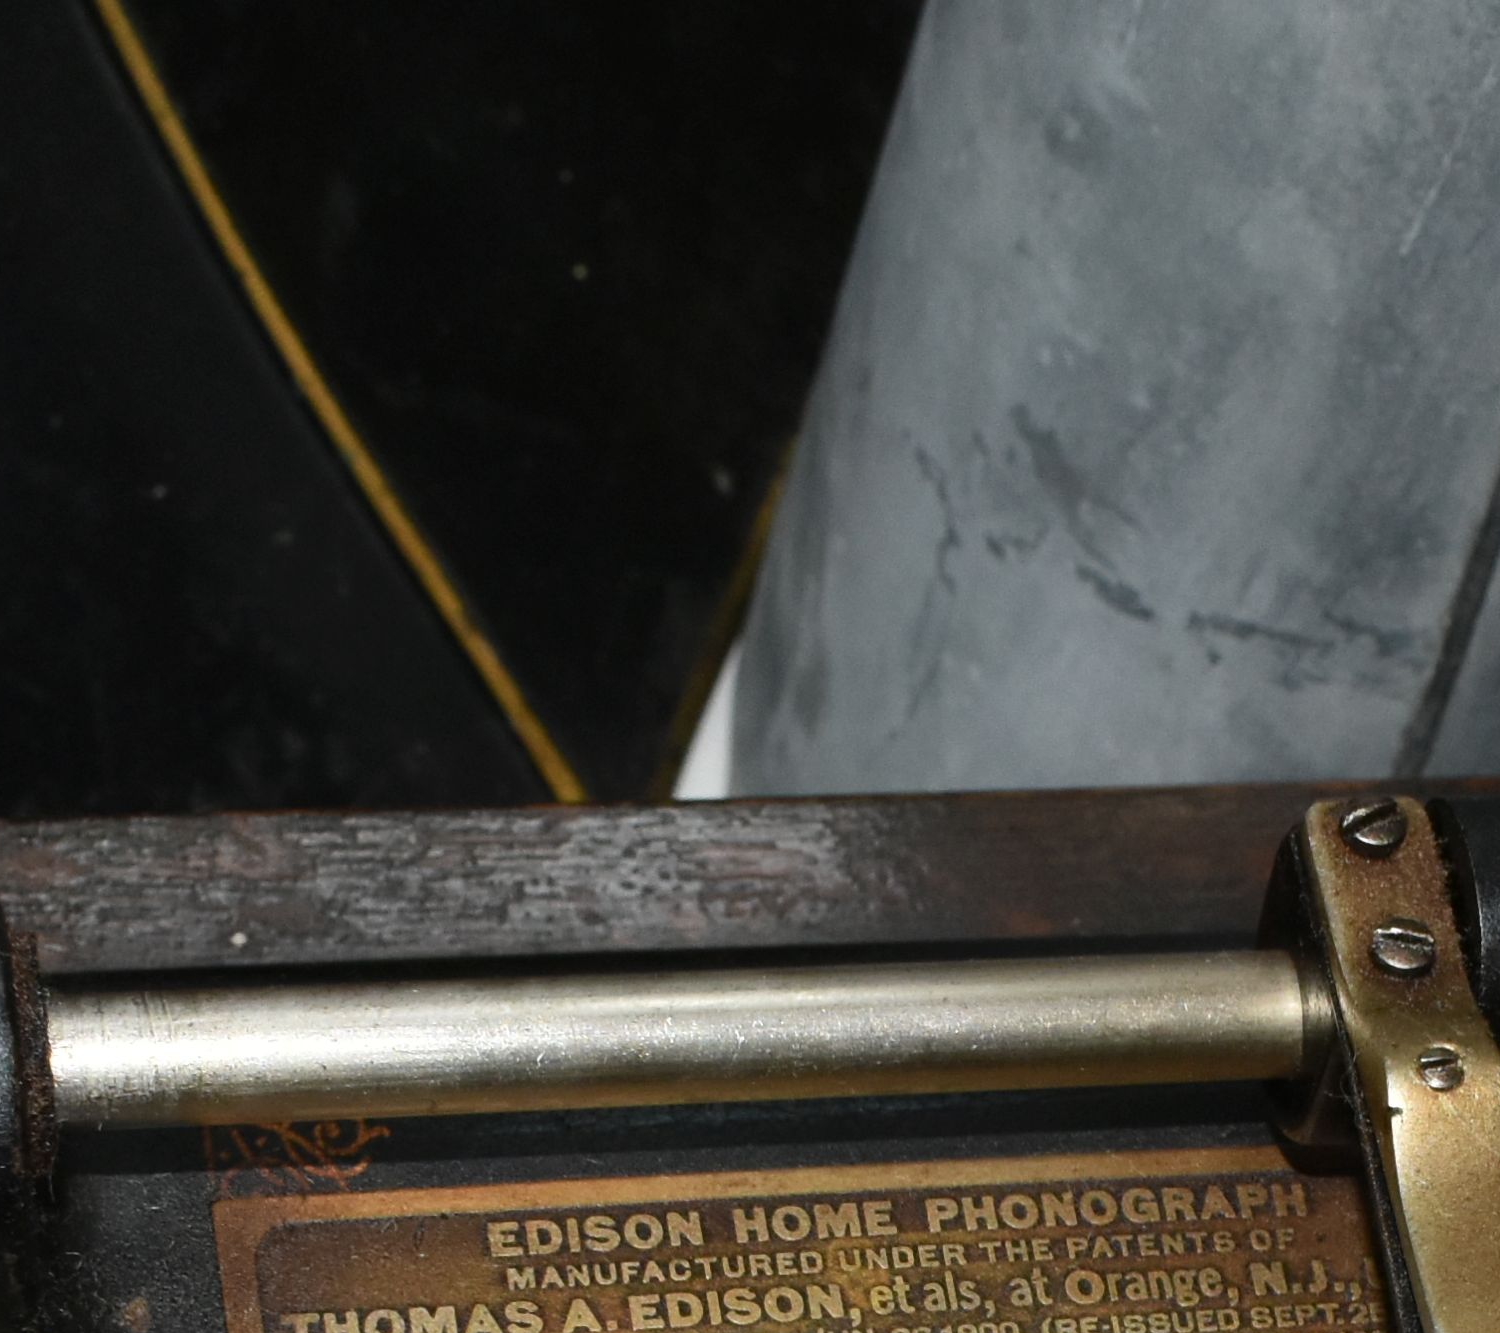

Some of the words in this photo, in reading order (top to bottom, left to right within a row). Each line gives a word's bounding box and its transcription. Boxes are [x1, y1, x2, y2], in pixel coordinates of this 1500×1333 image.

[488, 1212, 706, 1257] EDISON
[732, 1199, 898, 1246] HOME
[925, 1183, 1309, 1234] PHONOGRAPH
[507, 1251, 824, 1290] MANUFACTURED
[837, 1241, 968, 1271] UNDER
[979, 1236, 1054, 1264] THE
[1066, 1229, 1236, 1261] PATENTS
[1250, 1228, 1296, 1252] OF
[628, 1282, 863, 1331] EDISON,
[1009, 1265, 1049, 1307] at
[1063, 1264, 1240, 1309] Orange,
